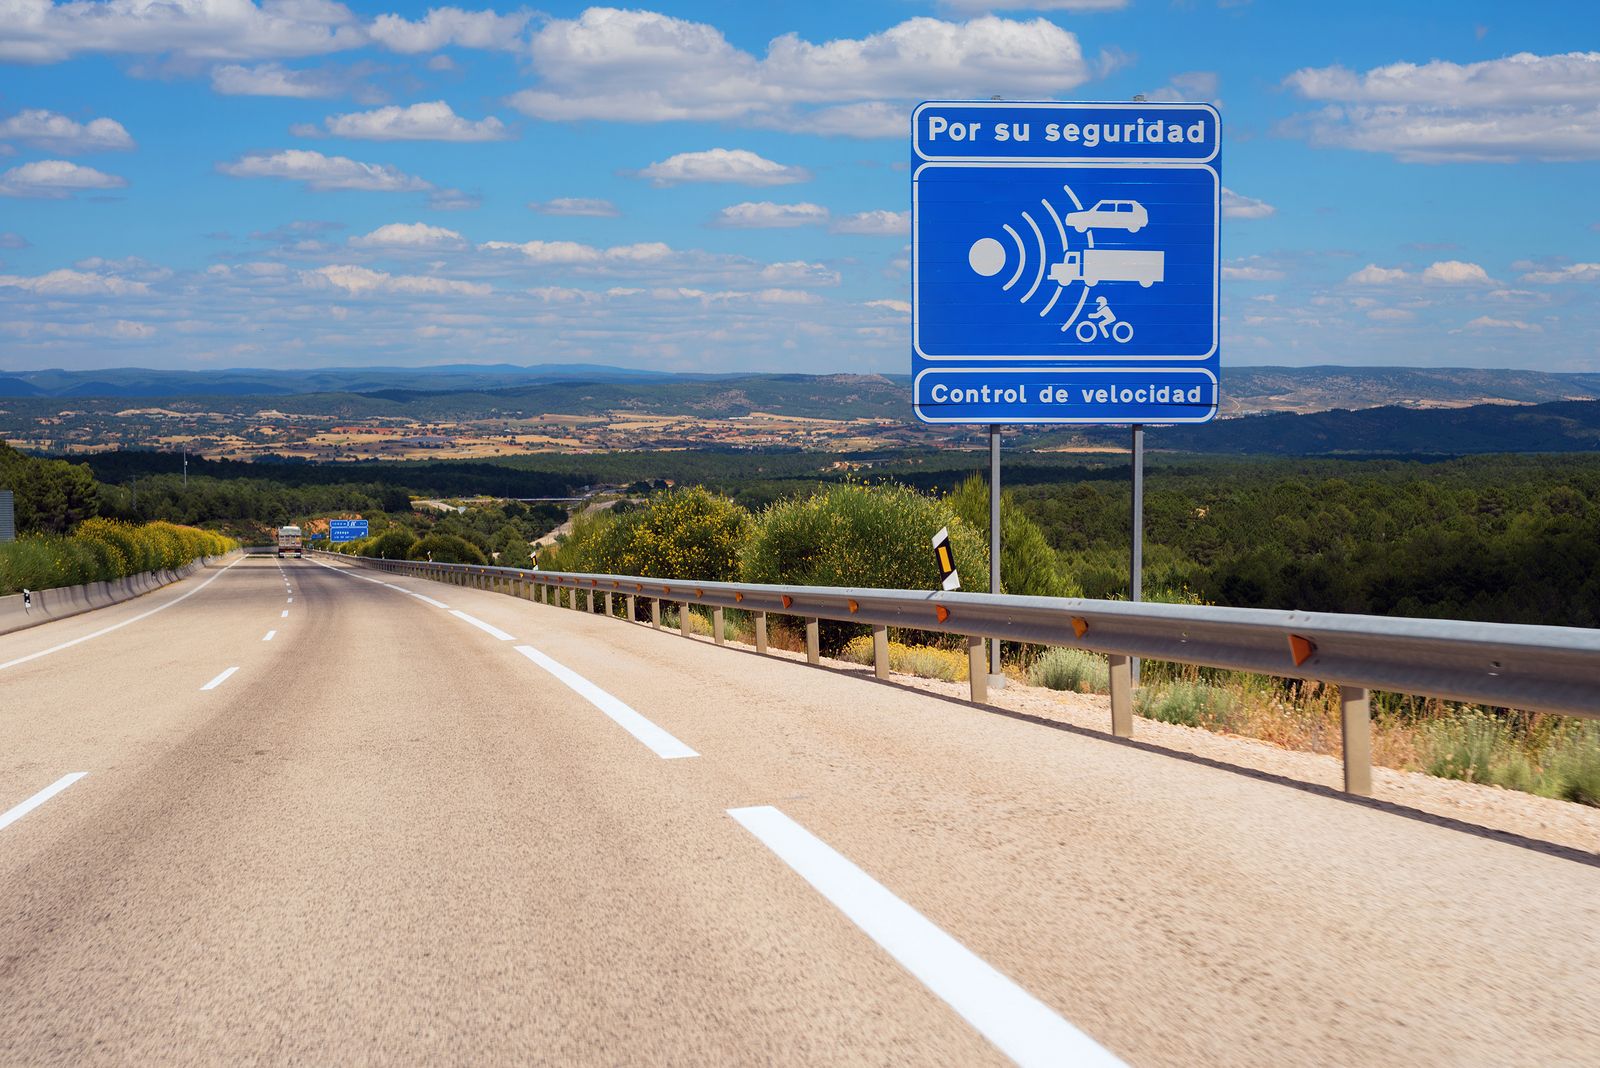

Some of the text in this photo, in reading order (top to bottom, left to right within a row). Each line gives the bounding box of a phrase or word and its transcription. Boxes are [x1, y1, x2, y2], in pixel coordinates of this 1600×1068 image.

[928, 116, 1205, 147] Por su seguridad
[931, 384, 1201, 403] Control de velocidad
